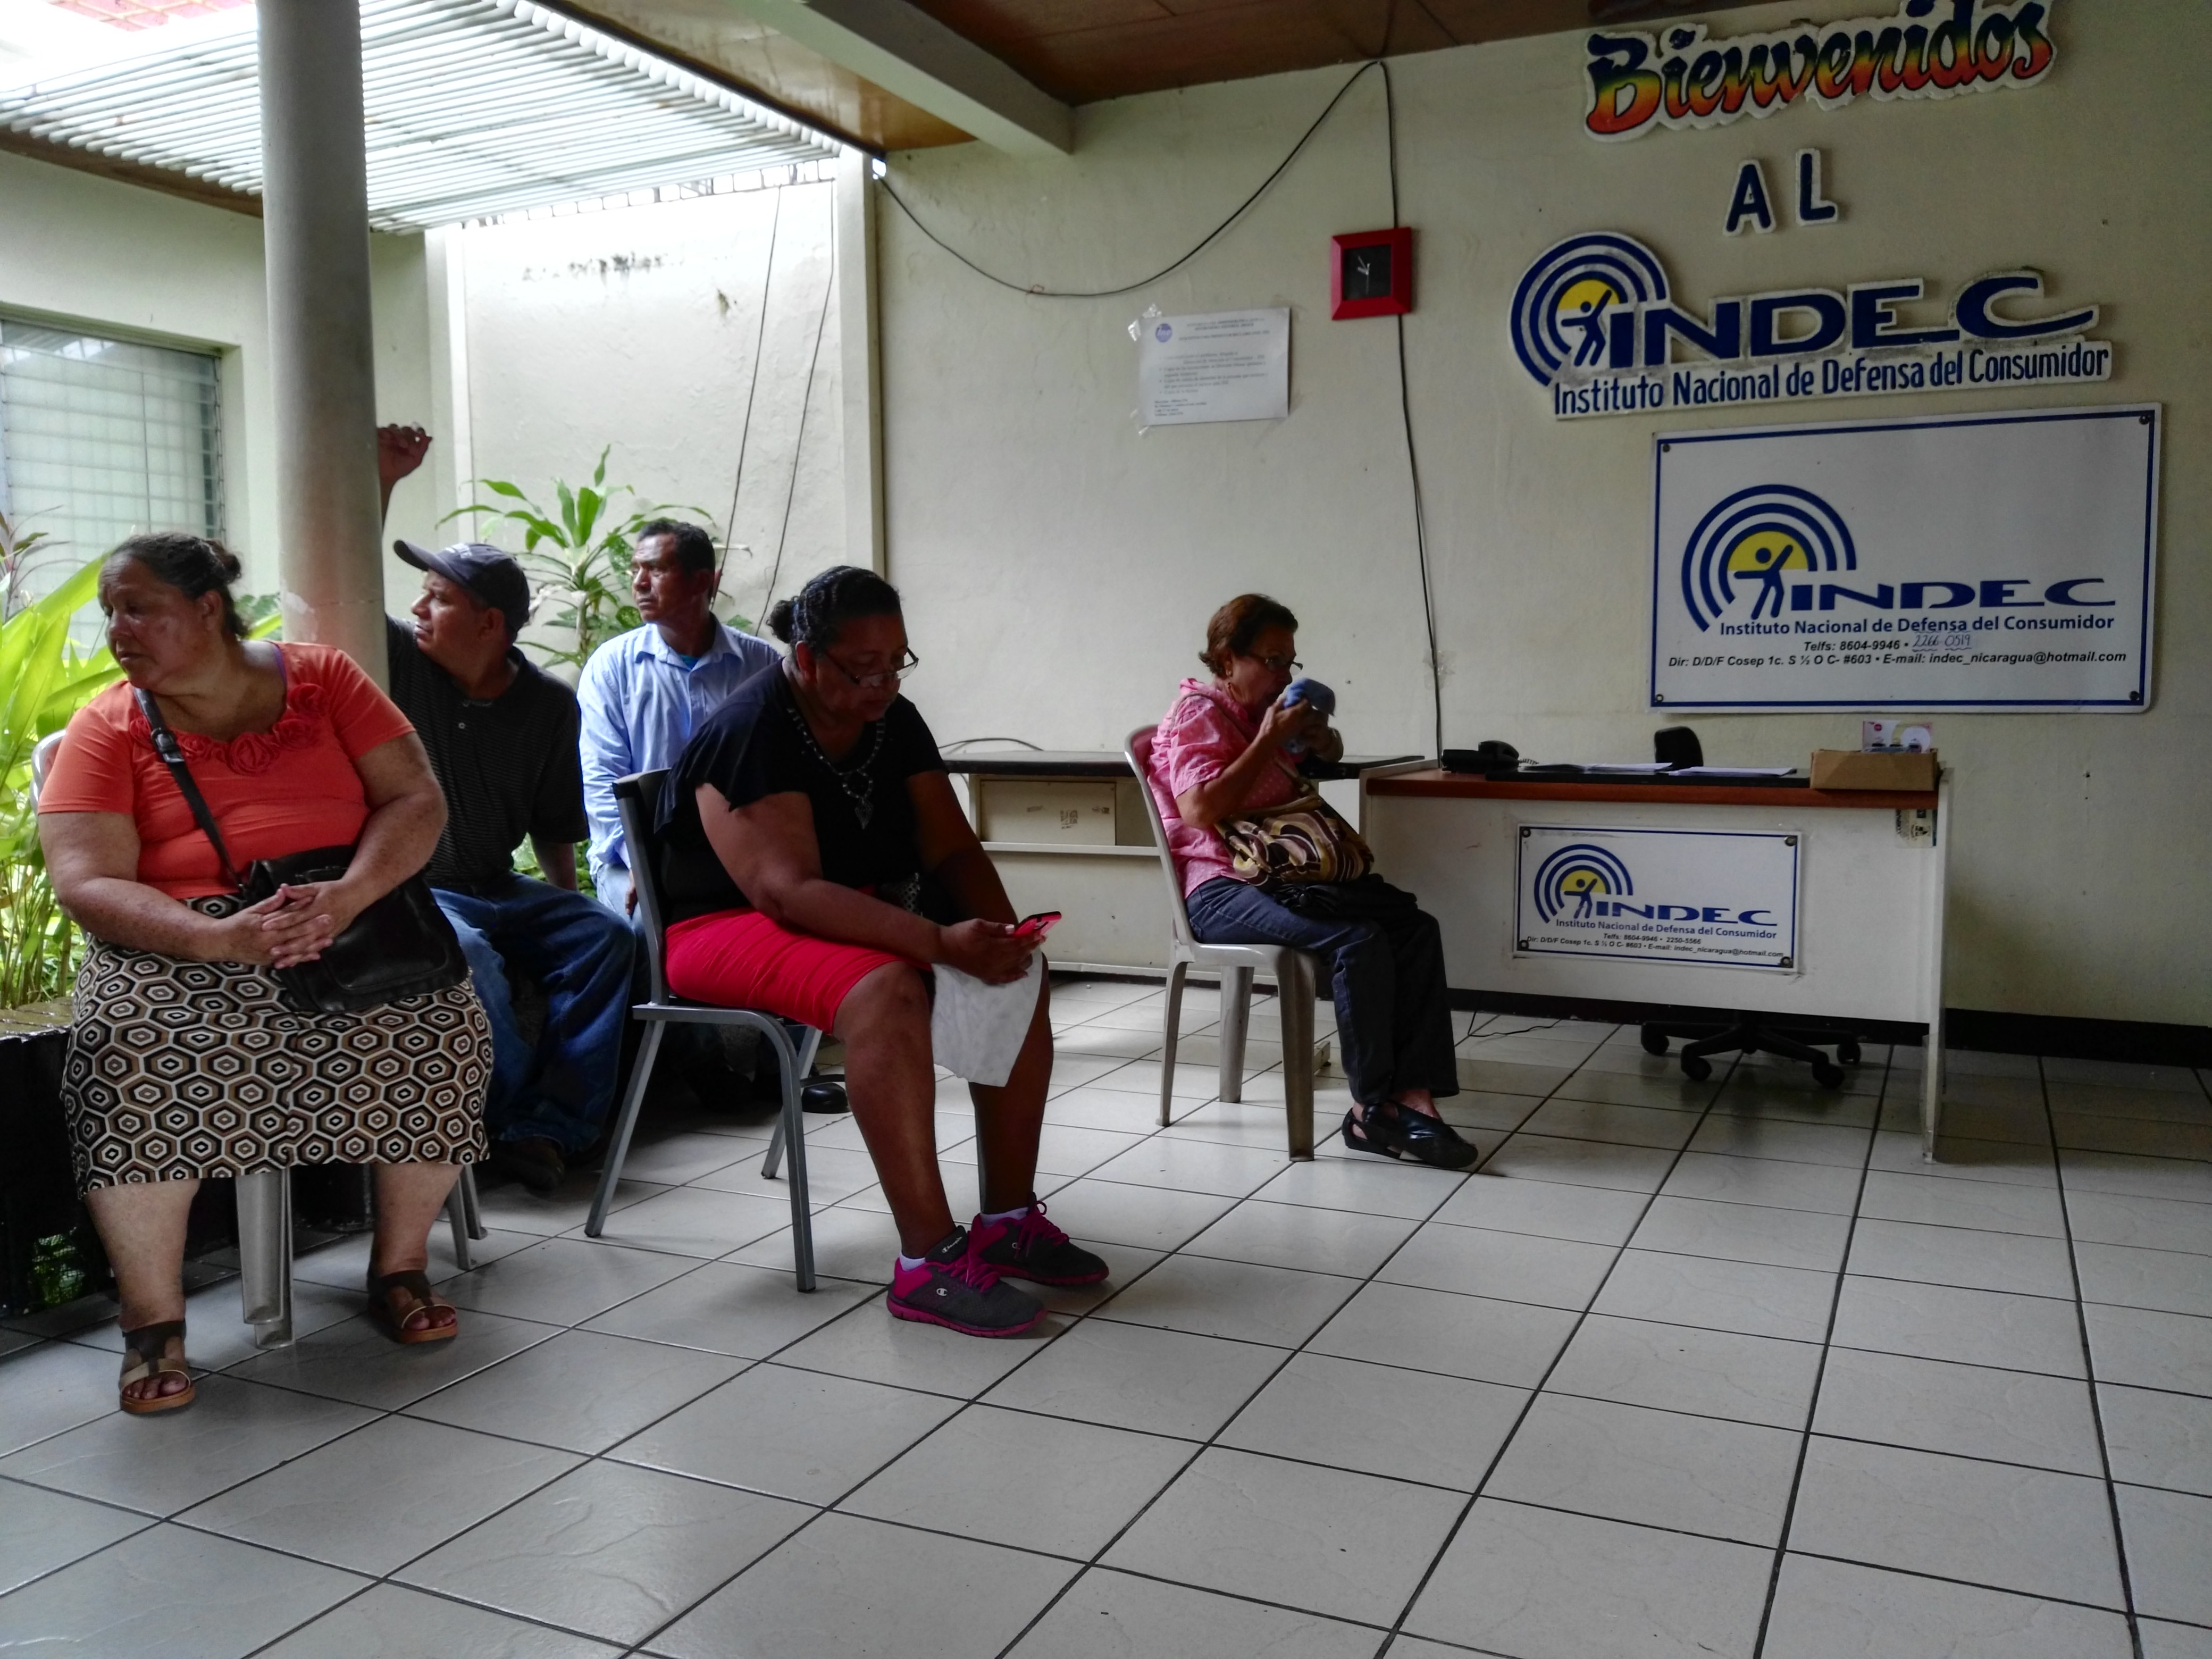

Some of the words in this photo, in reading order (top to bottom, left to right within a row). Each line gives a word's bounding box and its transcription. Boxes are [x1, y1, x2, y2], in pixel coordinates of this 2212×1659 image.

[1587, 0, 2052, 134] Bienvenidos
[1609, 276, 2094, 368] INDEC
[1554, 375, 1664, 415] Instituto
[1673, 364, 1779, 405] Nacional
[1786, 363, 1814, 396] de
[1822, 357, 1924, 394] Defensa
[1930, 351, 1963, 387] del
[1969, 343, 2109, 382] Consumidor
[1790, 577, 2116, 611] INDEC
[1720, 622, 1790, 635] Instituto
[1795, 619, 1867, 634] Nacional
[1871, 618, 1893, 632] de
[1898, 617, 1967, 632] Defensa
[1972, 616, 1999, 630] del
[2004, 614, 2114, 630] Consumidor
[1804, 641, 1836, 651] Telfs:
[1839, 640, 1900, 651] 8604-9946
[1669, 657, 1689, 667] Dir:
[1692, 656, 1724, 666] D/D/F
[1728, 656, 1764, 668] Cosep
[1769, 656, 1784, 666] 1c.
[1788, 656, 1796, 665] S
[1814, 655, 1823, 665] O
[1843, 654, 1872, 665] #603
[1883, 653, 1925, 664] E-mail:
[1929, 652, 2126, 665] indec_nicaragua@hotmail.com
[1596, 901, 1778, 926] INDEC
[1556, 919, 1596, 928] Instituto
[1598, 921, 1639, 931] Nacional
[1642, 924, 1654, 932] de
[1656, 925, 1695, 934] Defensa
[1698, 927, 1713, 935] del
[1715, 928, 1777, 939] Consumidor
[1674, 945, 1783, 957] indec_nicaragua@hotmail.com
